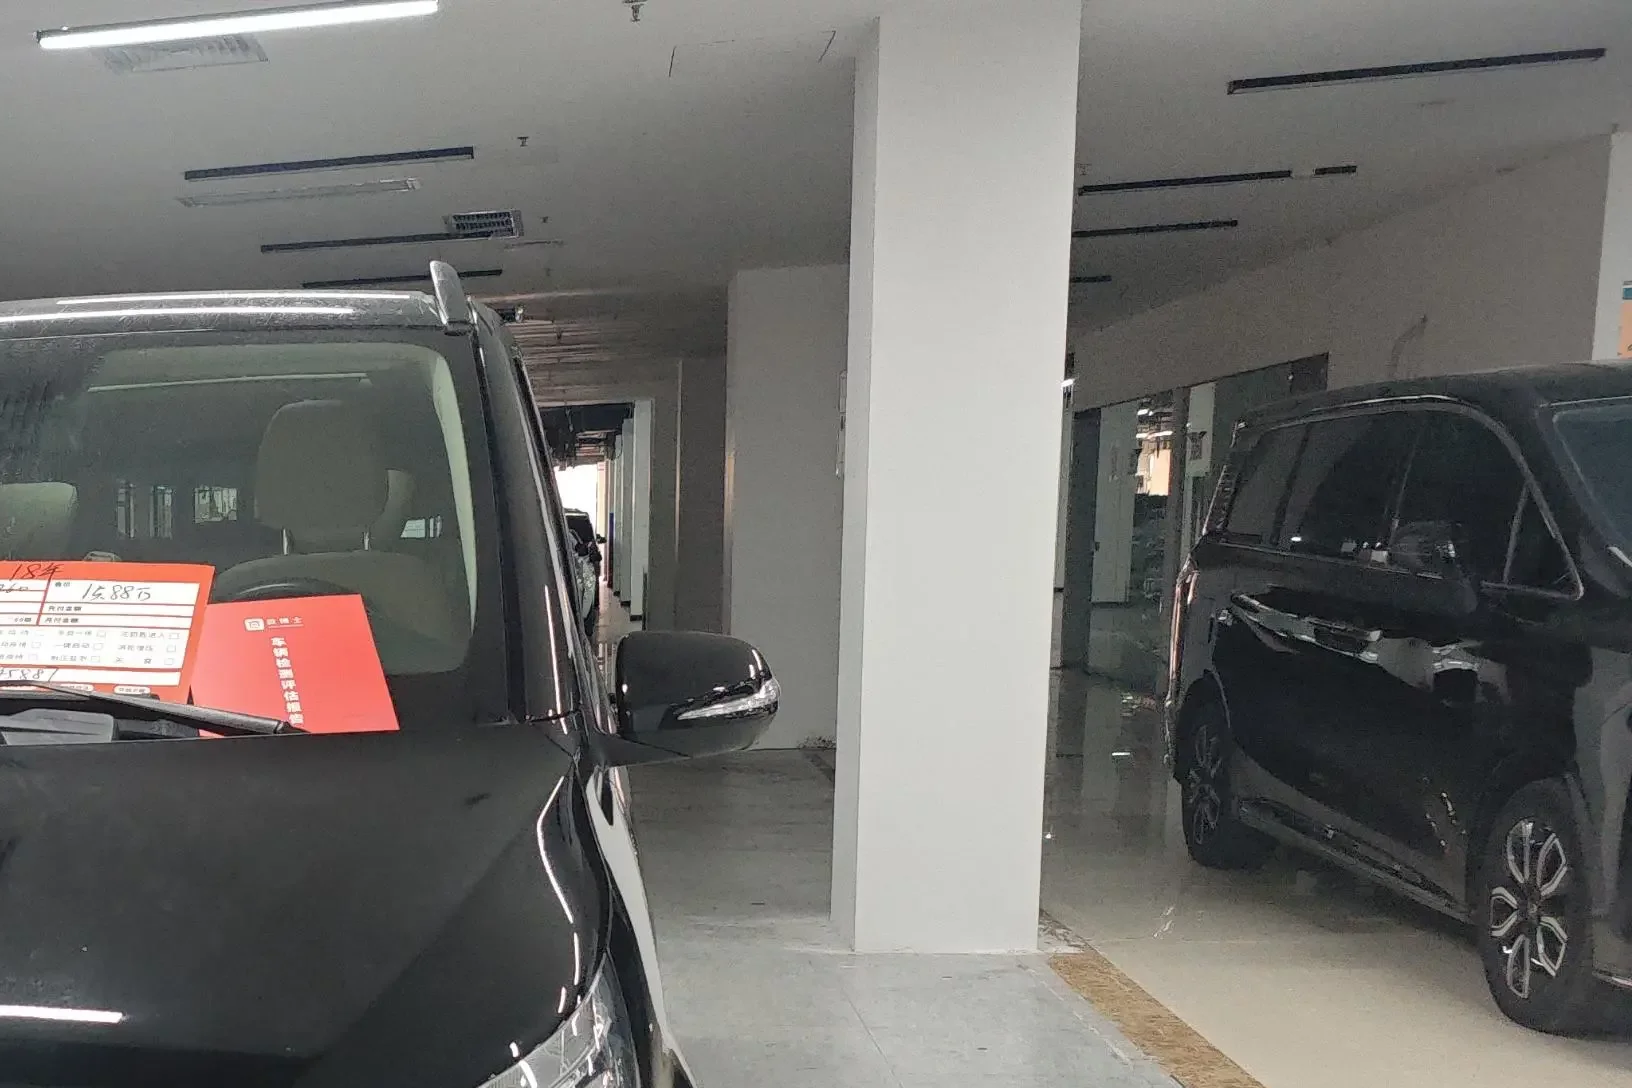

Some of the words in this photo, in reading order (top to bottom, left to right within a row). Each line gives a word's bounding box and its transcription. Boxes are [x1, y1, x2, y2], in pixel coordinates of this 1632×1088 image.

[271, 637, 304, 726] 车辆检测评估报告
